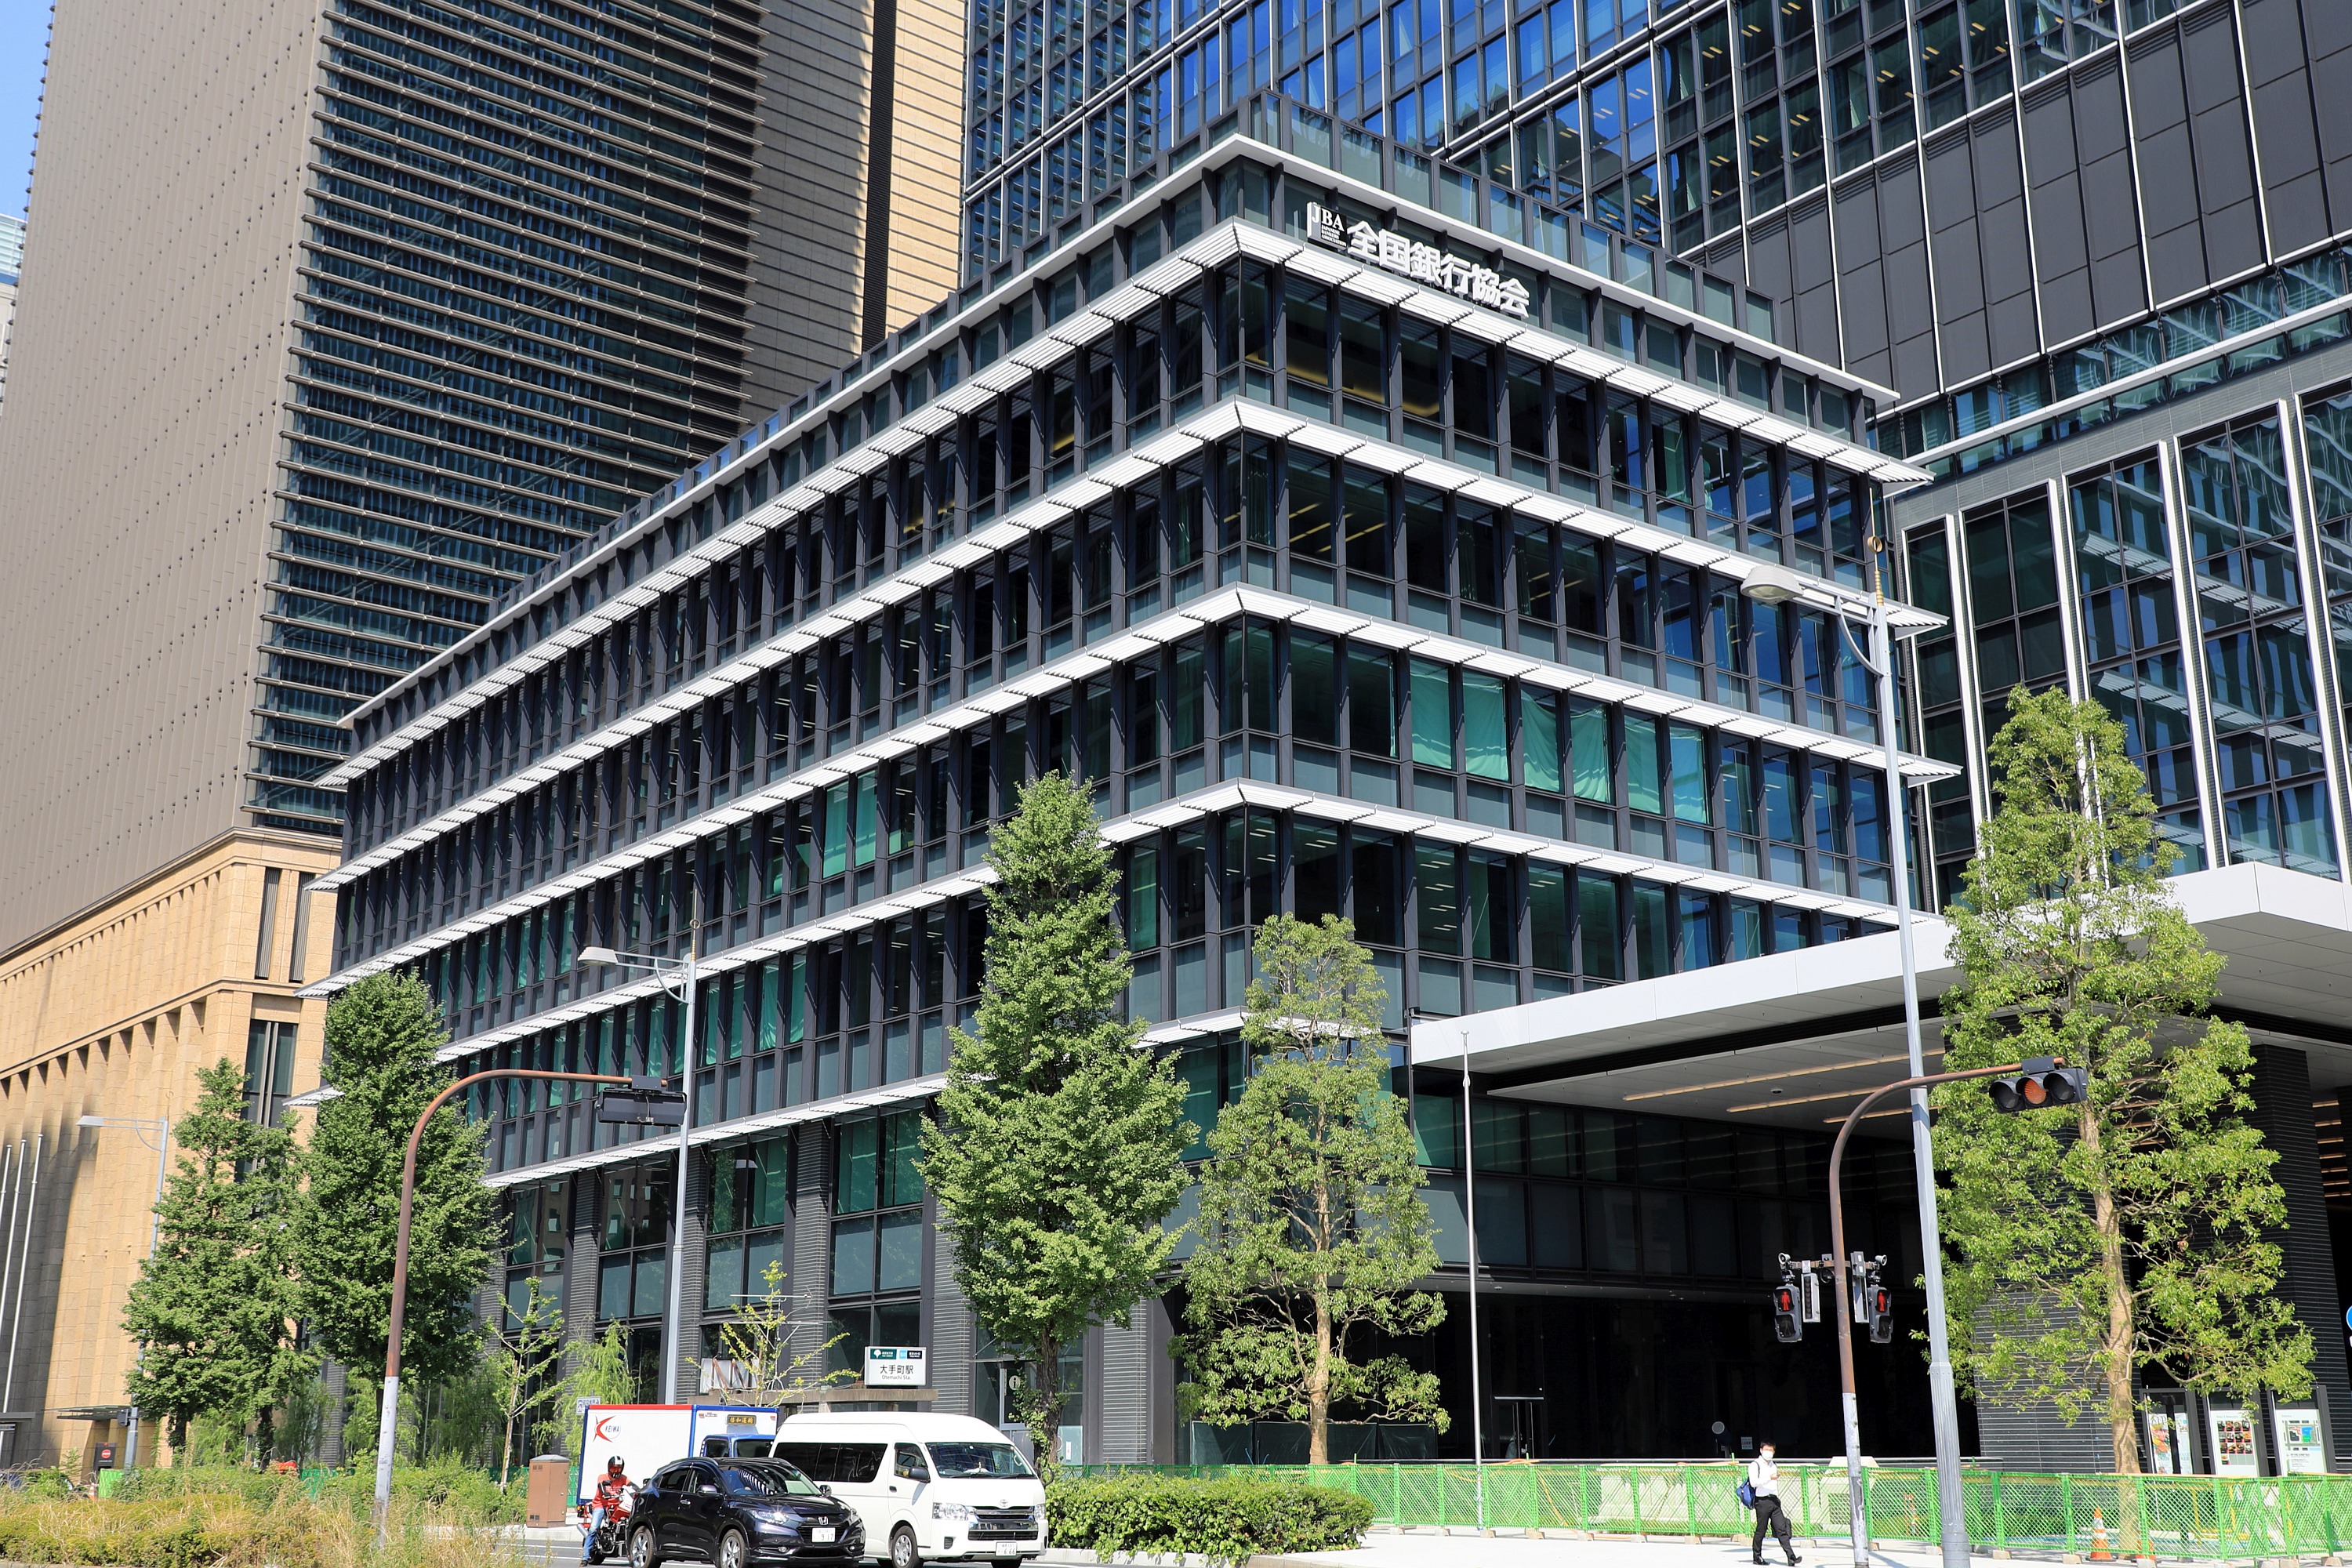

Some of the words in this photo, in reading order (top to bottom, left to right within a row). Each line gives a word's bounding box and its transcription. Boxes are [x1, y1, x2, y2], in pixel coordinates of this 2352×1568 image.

[1312, 205, 1345, 232] JBA
[1347, 220, 1530, 318] 全国銀行協会
[880, 1365, 913, 1374] 大手町駅
